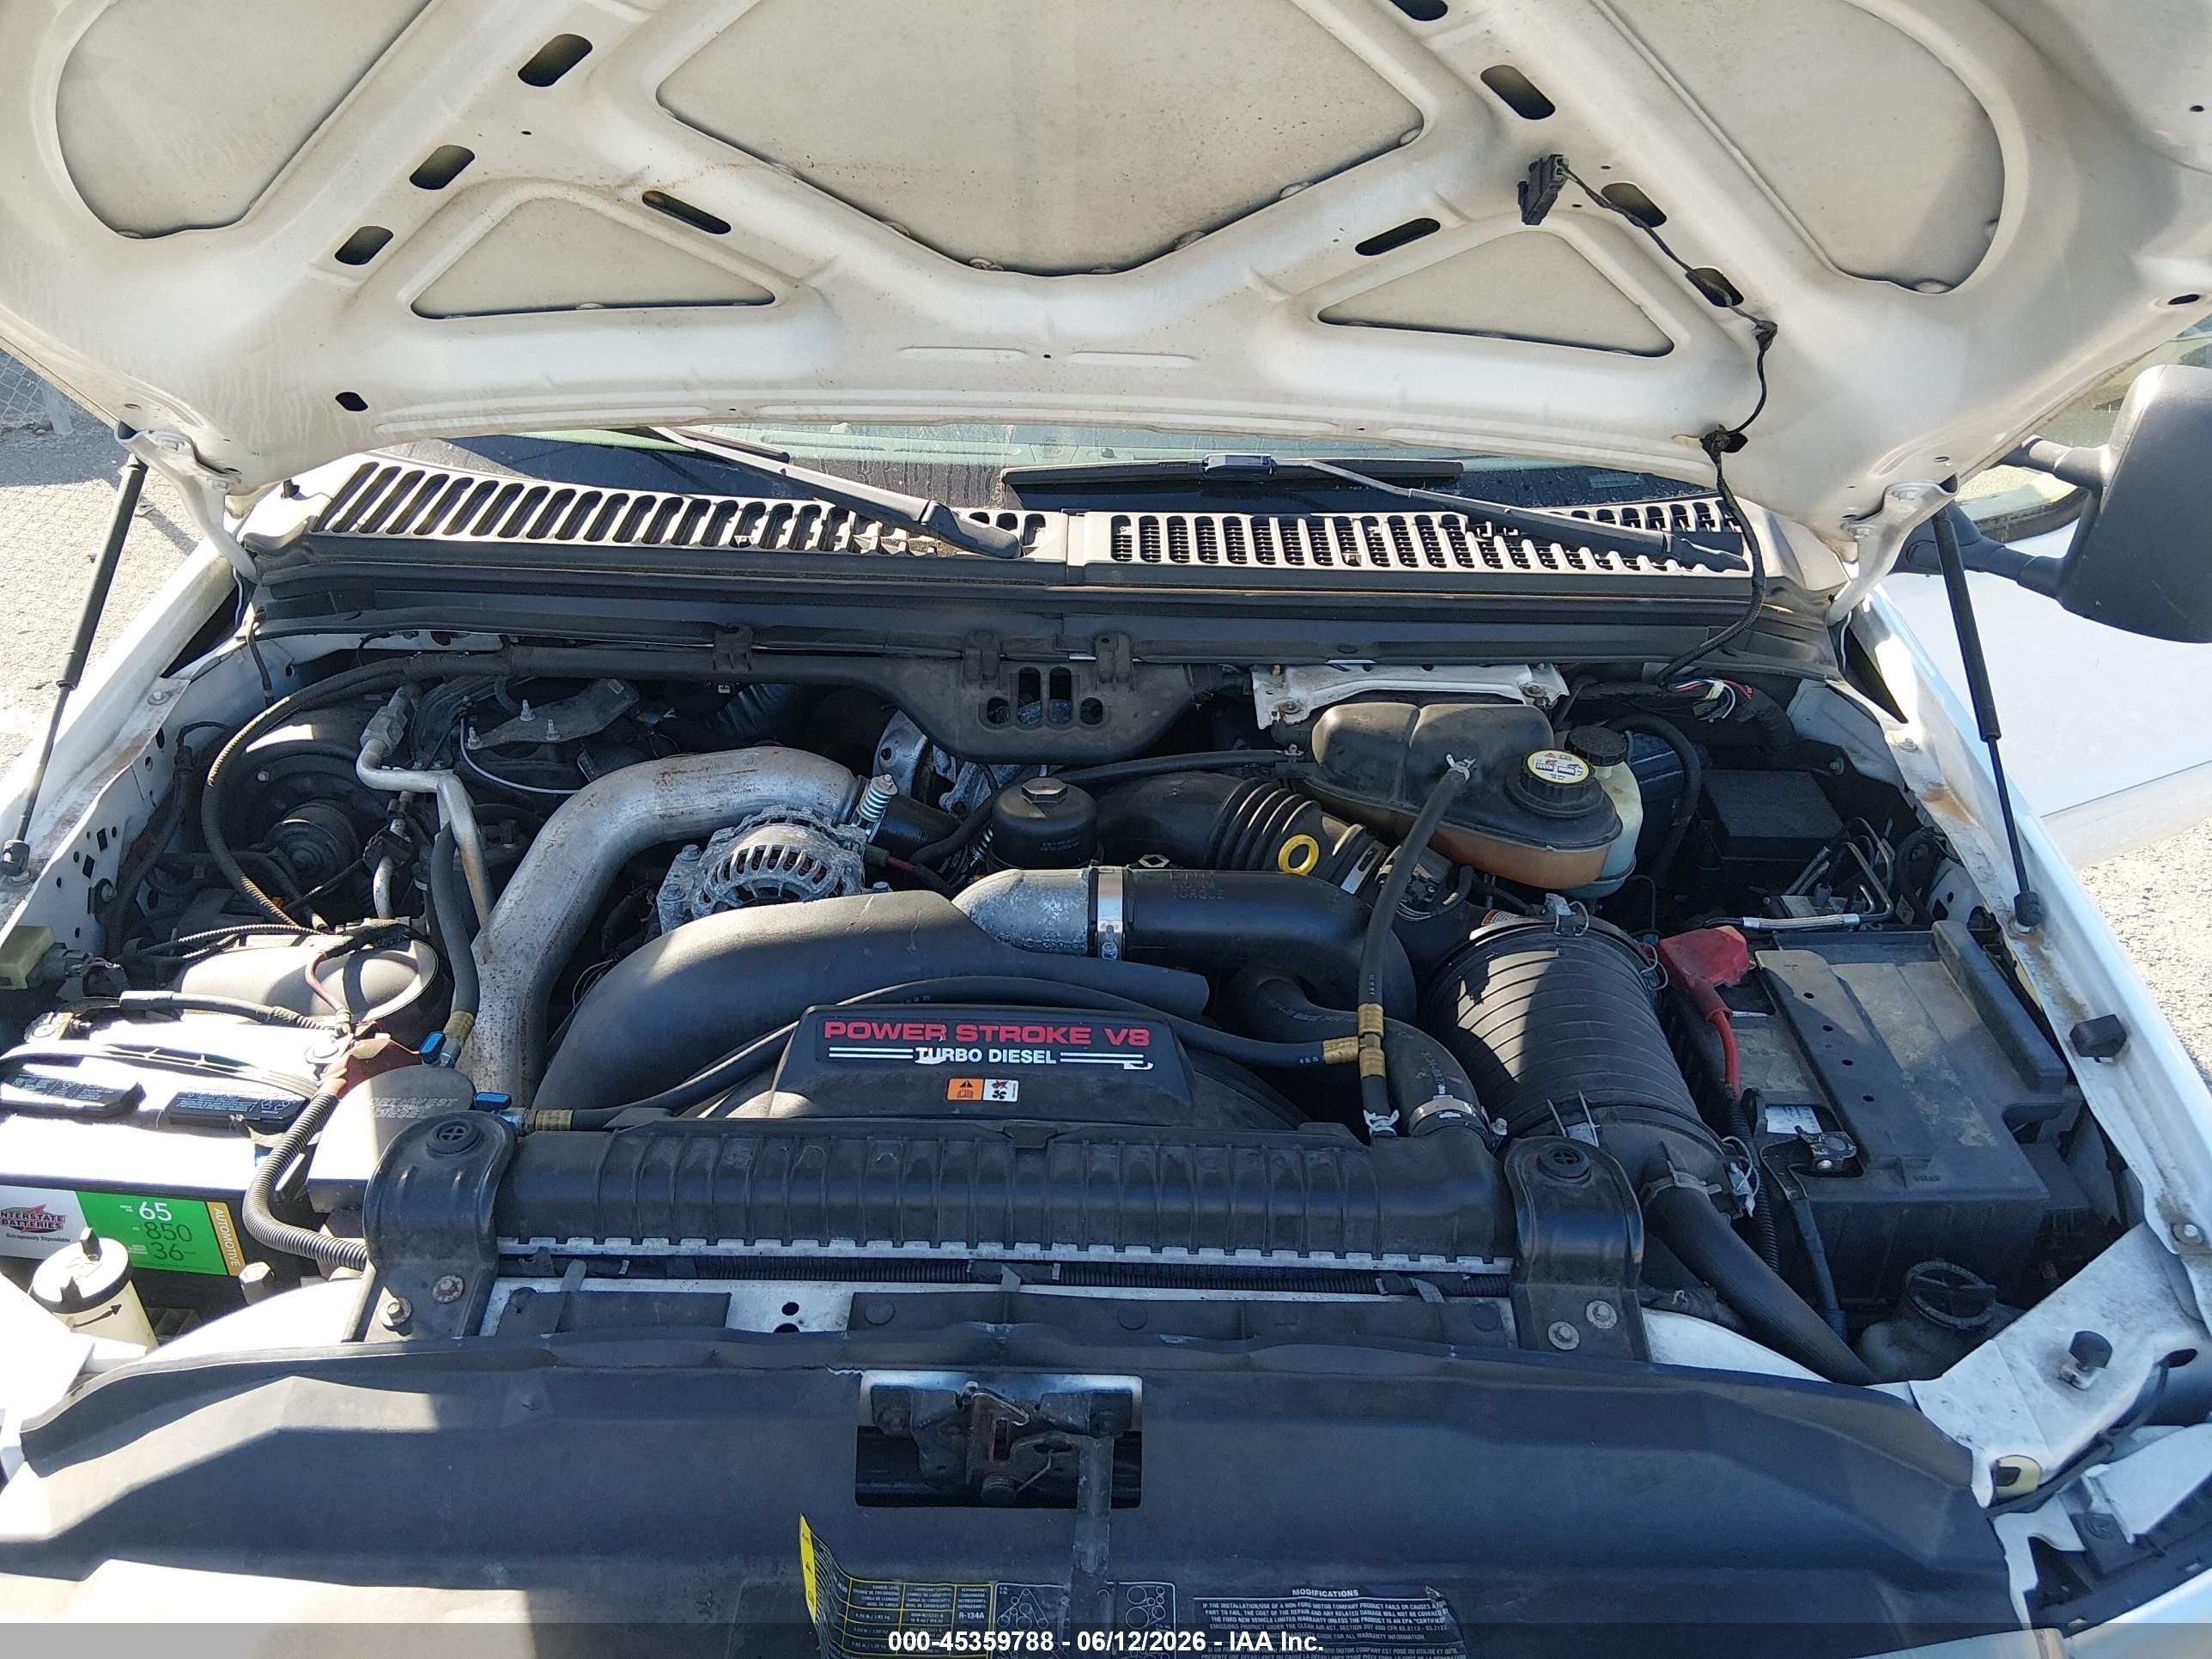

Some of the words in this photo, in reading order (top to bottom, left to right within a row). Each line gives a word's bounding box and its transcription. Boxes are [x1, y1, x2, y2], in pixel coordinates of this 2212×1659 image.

[824, 1021, 946, 1042] POWER
[955, 1024, 1091, 1045] STROKE
[1104, 1028, 1151, 1047] V8
[915, 1046, 982, 1064] TURBO
[988, 1048, 1057, 1064] DIESEL
[0, 1211, 64, 1222] NTERSTATE
[139, 1201, 172, 1221] 65
[2, 1218, 63, 1229] BATTERIES
[144, 1222, 192, 1243] 850
[213, 1206, 240, 1267] AUTOMOTIVE
[151, 1242, 185, 1261] 36
[1292, 1589, 1359, 1597] MODIFICATIONS
